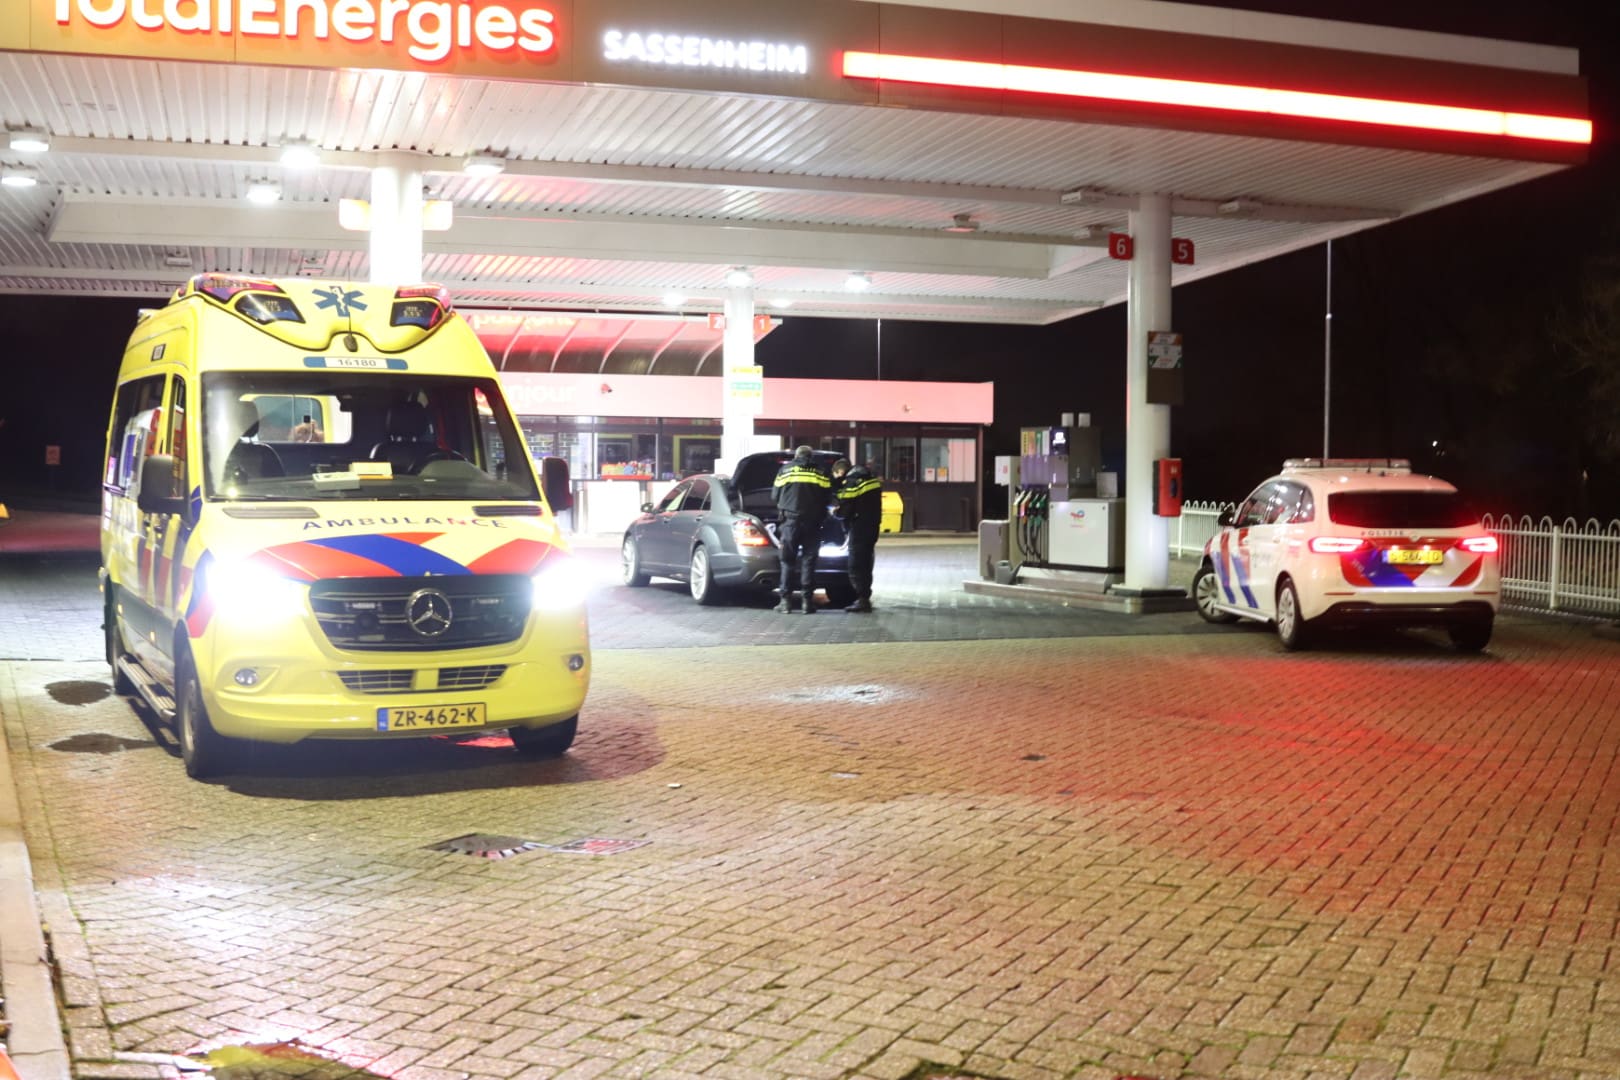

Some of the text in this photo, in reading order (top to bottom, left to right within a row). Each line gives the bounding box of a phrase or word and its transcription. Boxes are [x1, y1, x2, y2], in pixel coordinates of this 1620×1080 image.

[603, 29, 808, 75] SASSENHEIM
[1116, 238, 1127, 256] 6
[1178, 242, 1189, 260] 5
[713, 316, 723, 329] 2
[759, 317, 765, 330] 1
[338, 359, 377, 367] 16180
[505, 377, 577, 410] njour
[302, 516, 508, 531] AMBULANCE
[394, 707, 477, 727] ZR-462-K
